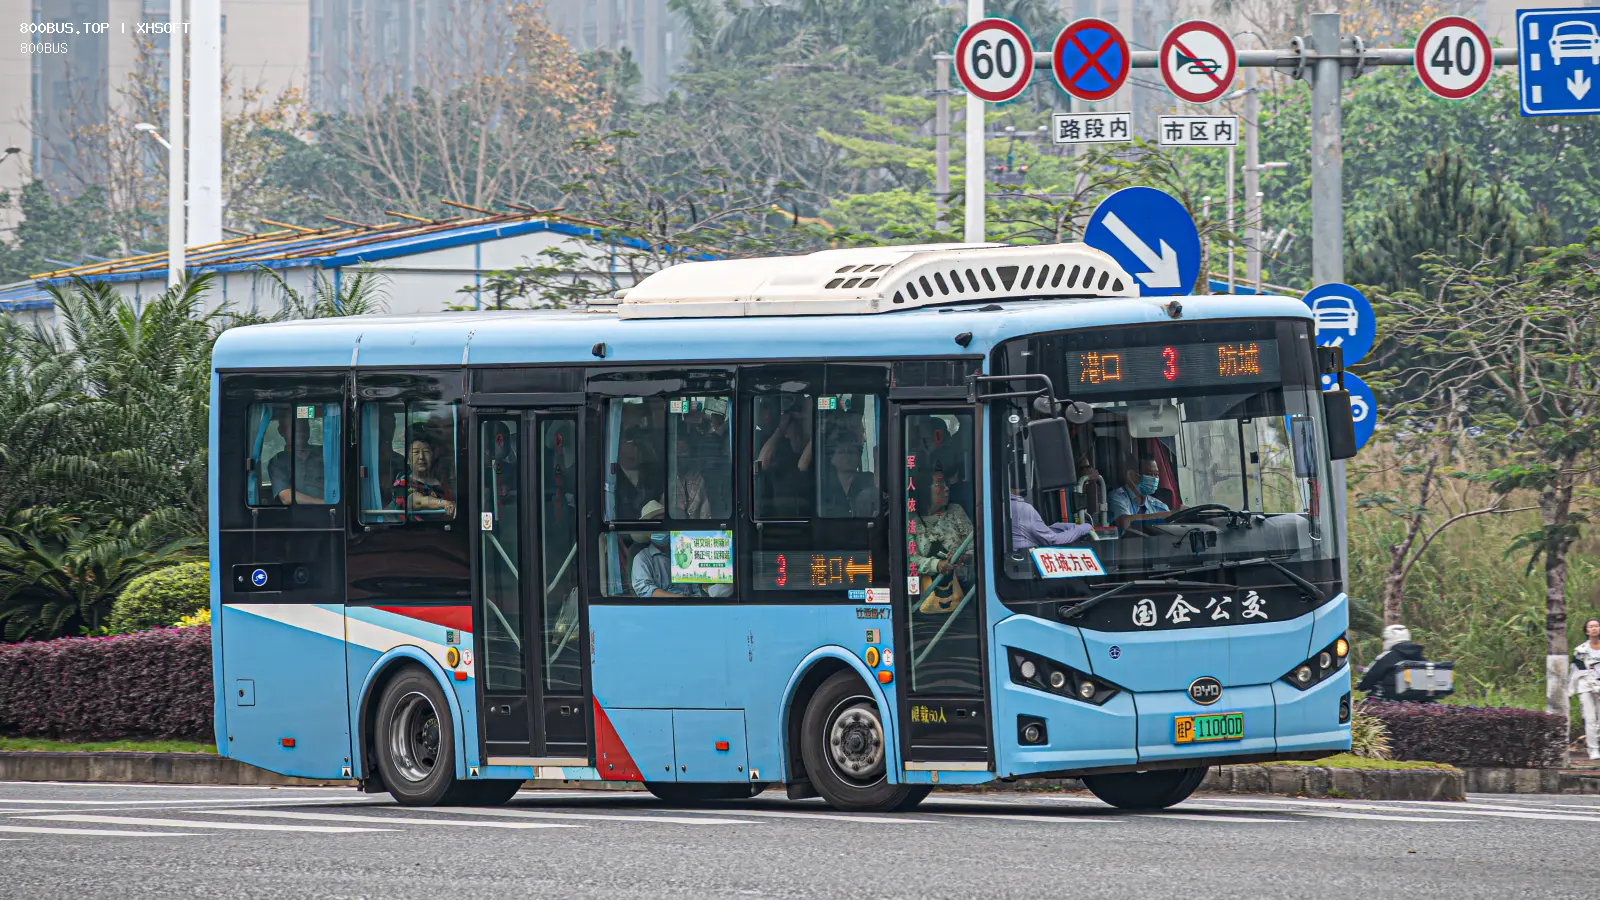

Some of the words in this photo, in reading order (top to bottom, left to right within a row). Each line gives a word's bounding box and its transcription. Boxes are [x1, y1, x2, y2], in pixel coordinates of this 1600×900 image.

[971, 37, 1017, 80] 60
[1430, 35, 1476, 76] 40
[1059, 117, 1128, 140] 路段内
[1163, 120, 1232, 142] 市区内
[1080, 351, 1120, 384] 港口
[1162, 346, 1177, 380] 3
[1217, 342, 1260, 377] 防城
[906, 455, 919, 577] 军人依法优先
[776, 553, 787, 586] 3
[811, 554, 843, 586] 港口
[1040, 553, 1099, 574] 防城方向
[1132, 590, 1269, 627] 国企公交
[1193, 684, 1219, 697] BYD
